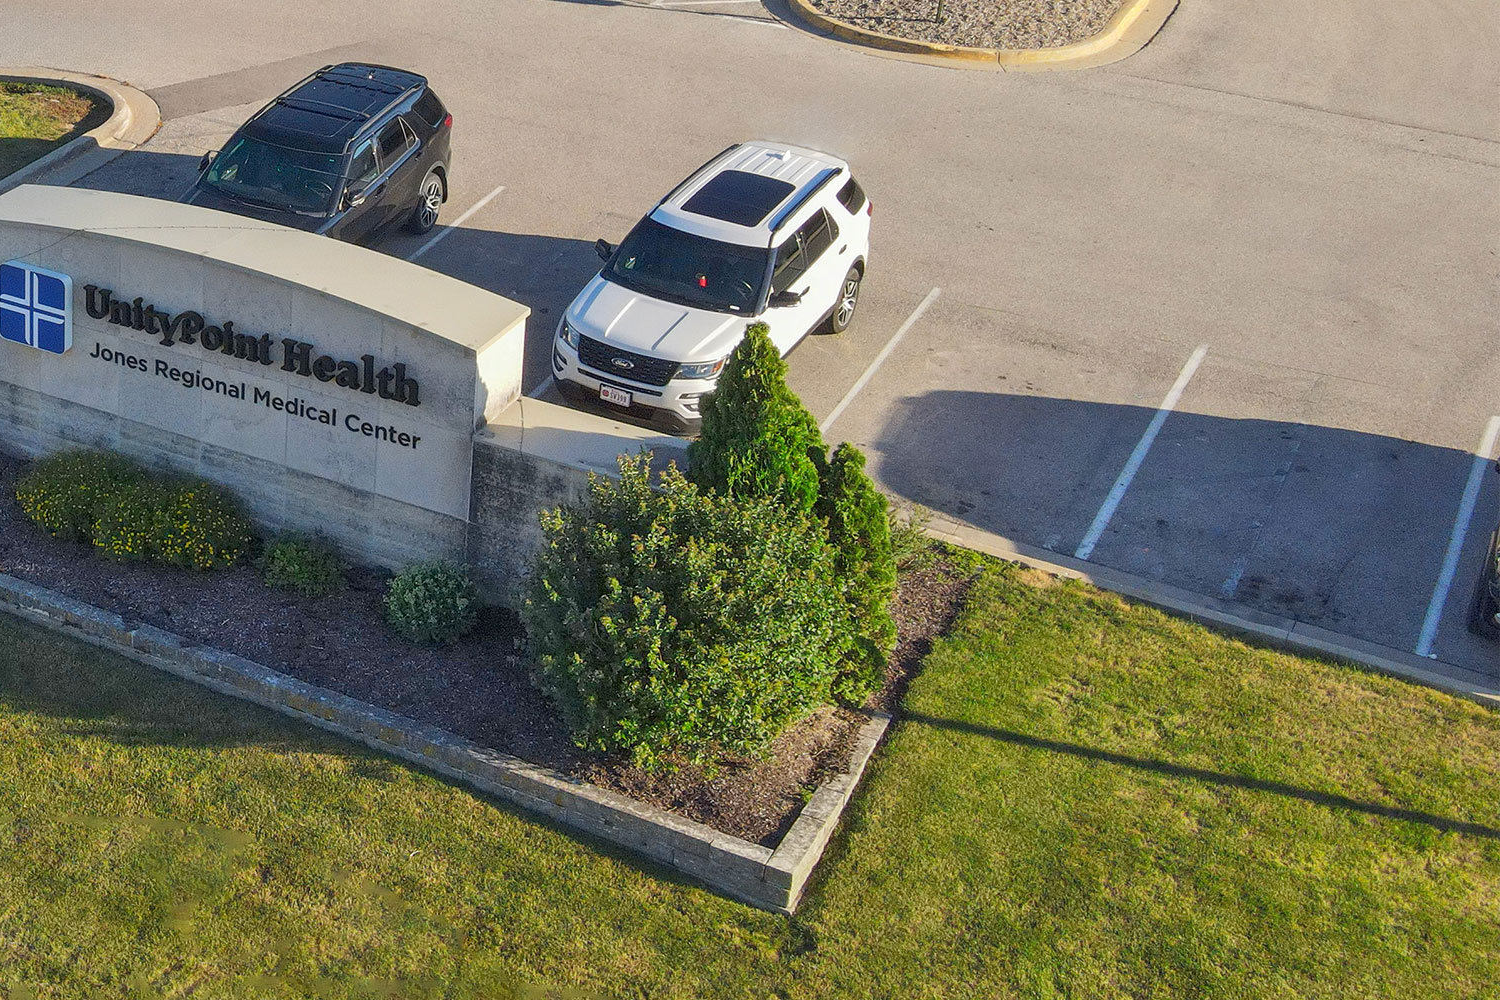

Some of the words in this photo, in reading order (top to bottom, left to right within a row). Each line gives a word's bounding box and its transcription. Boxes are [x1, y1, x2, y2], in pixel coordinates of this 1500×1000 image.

[83, 284, 276, 366] UnityPoint
[281, 337, 421, 407] Health
[90, 342, 148, 373] Jones
[156, 359, 245, 401] Regional
[253, 386, 337, 427] Medical
[344, 414, 421, 450] Center
